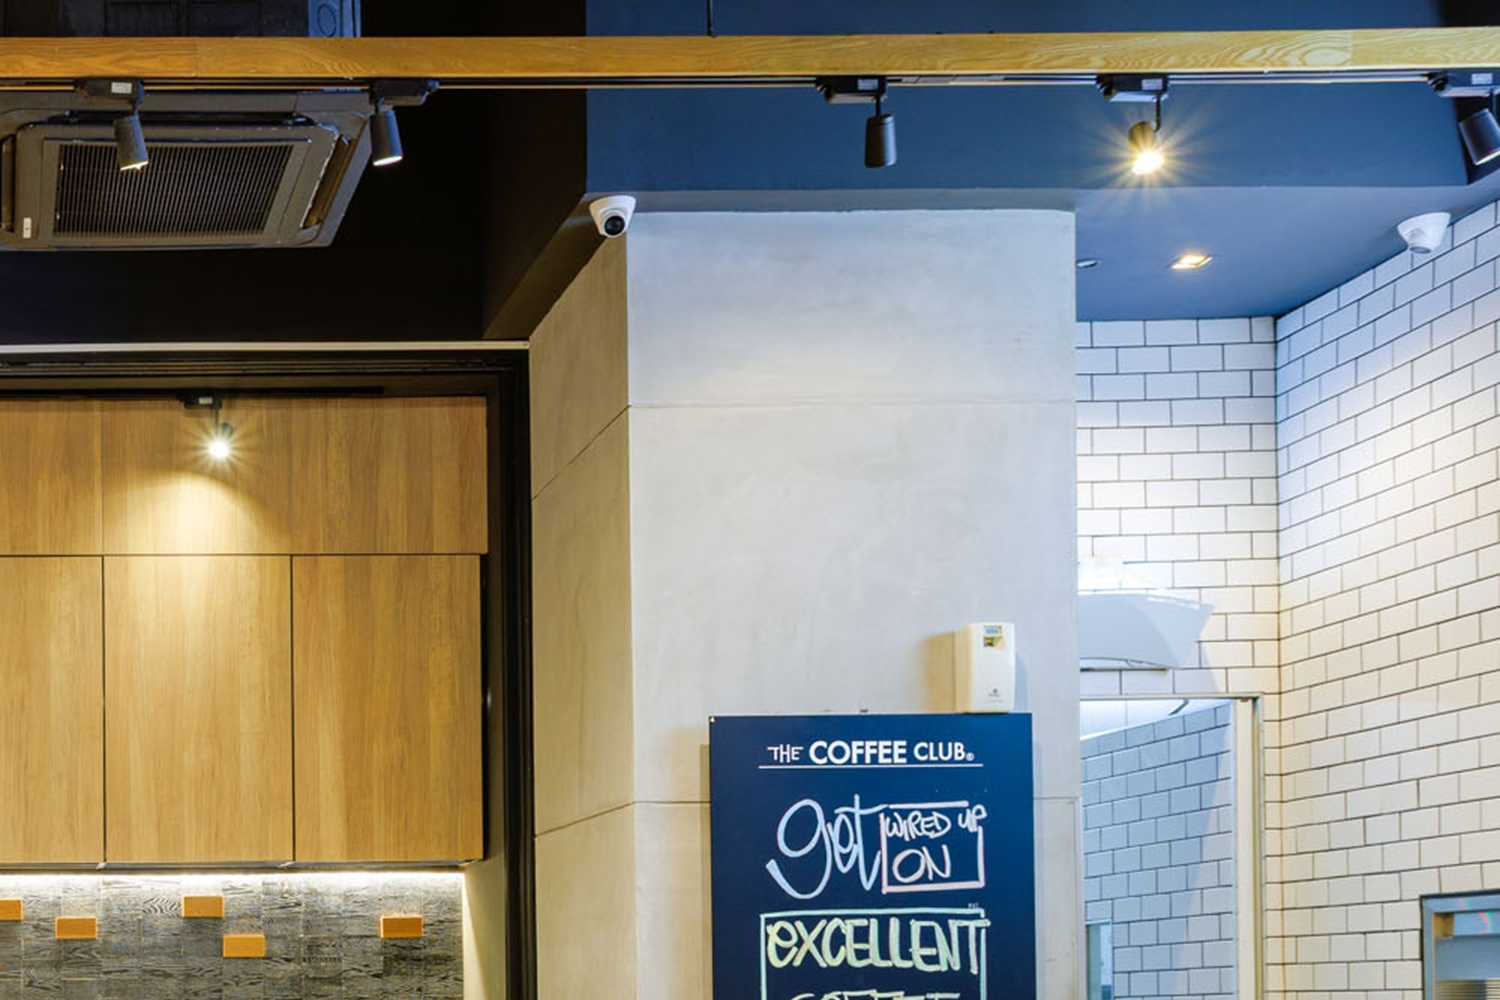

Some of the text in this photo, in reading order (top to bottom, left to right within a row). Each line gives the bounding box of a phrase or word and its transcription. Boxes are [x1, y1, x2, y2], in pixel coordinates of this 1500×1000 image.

[767, 743, 804, 764] THE
[808, 740, 907, 764] COFFEE
[765, 794, 988, 899] get WIRED UP
[892, 844, 951, 883] ON
